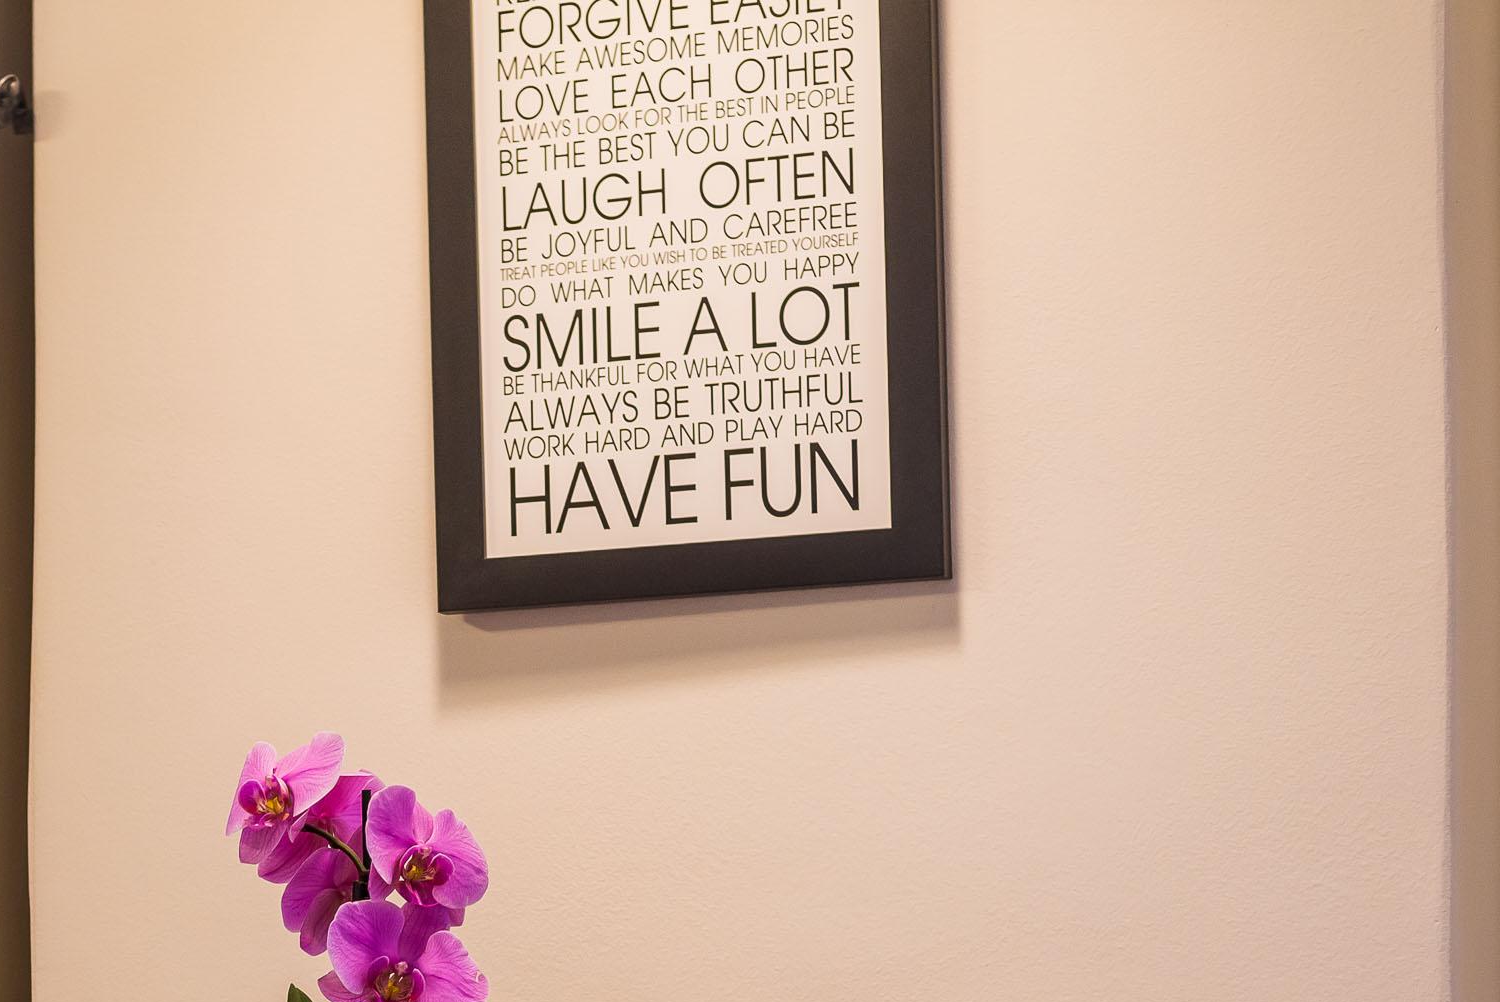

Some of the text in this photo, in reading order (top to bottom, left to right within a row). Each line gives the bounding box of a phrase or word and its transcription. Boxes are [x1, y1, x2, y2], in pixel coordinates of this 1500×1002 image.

[497, 14, 854, 82] MAKE AWESOME MEMORIES
[498, 0, 841, 53] FORGIVE EAS
[497, 85, 855, 144] ALWAYS LOOK FOR THE BEST IN PEOPLE
[499, 48, 854, 123] LOVE EACH OTHER
[499, 109, 855, 176] BE THE BEST YOU CAN BE
[502, 147, 854, 232] LAUGH OFTEN
[500, 232, 858, 281] TREAT PEOPLE LIKE YOU WISH TO BE TREATED YOURSELF
[501, 201, 857, 263] BE JOYFUL AND CAREFREE
[502, 252, 859, 309] DO WHAT MAKES YOU HAPPY
[503, 281, 860, 372] SMILE A LOT
[503, 344, 860, 396] BE THANKFUL FOR WHAT YOU HAVE
[504, 371, 863, 433] ALWAYS BE TRUTHFUL
[503, 409, 862, 461] WORK HARD AND PLAY HARD
[510, 438, 860, 537] HAVE FUN
